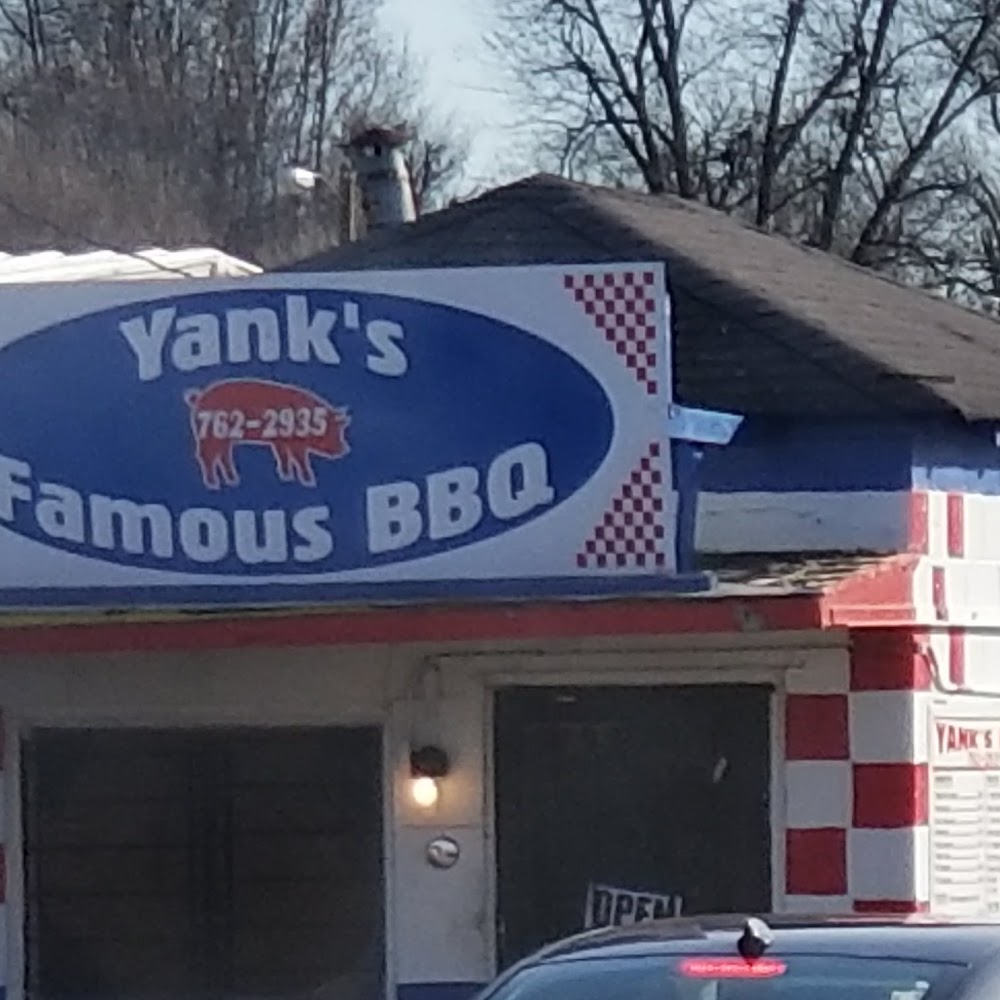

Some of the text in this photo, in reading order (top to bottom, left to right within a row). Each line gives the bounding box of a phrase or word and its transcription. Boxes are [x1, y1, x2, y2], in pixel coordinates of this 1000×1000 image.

[119, 295, 408, 381] Yank's
[199, 406, 328, 440] 762-2935
[0, 442, 554, 564] Famous BBQ
